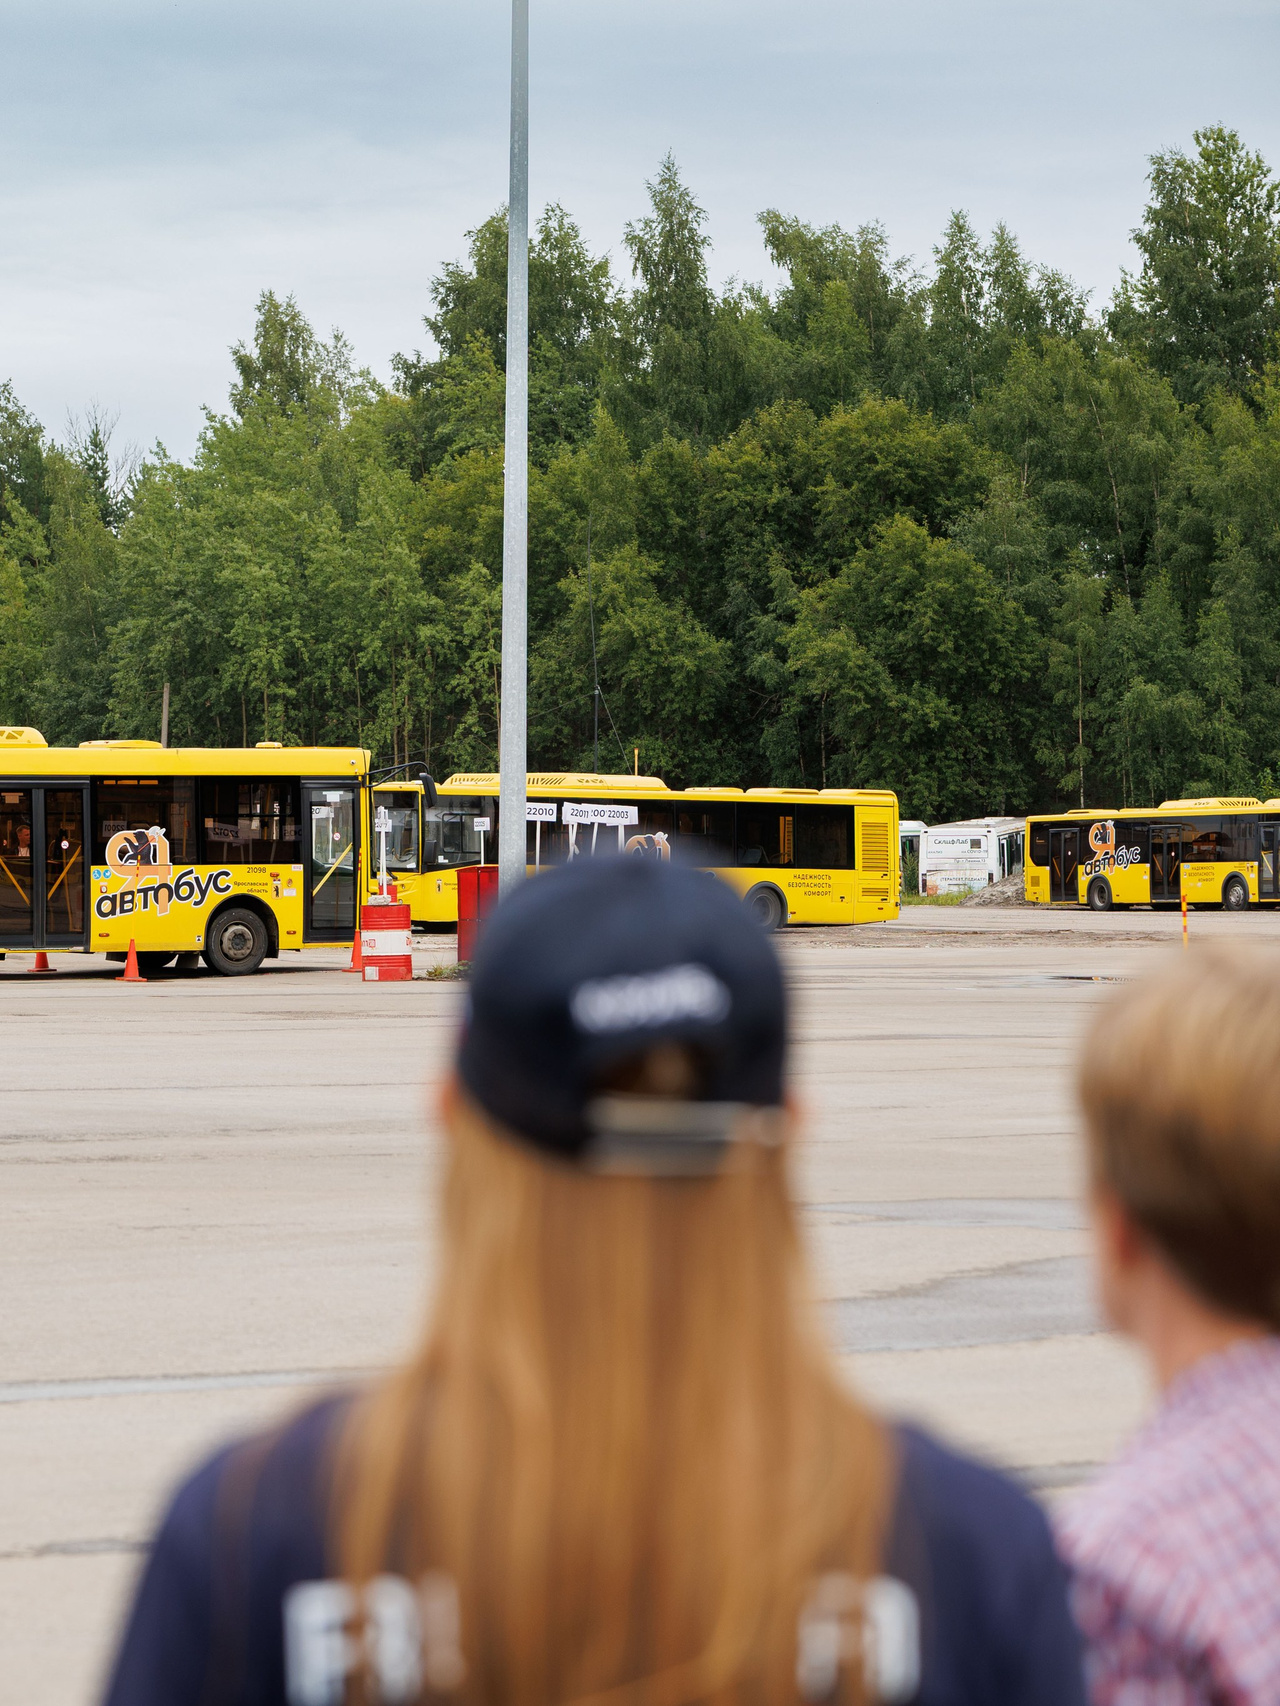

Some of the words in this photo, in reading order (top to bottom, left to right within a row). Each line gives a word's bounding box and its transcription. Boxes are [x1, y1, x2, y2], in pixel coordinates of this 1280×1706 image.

[527, 807, 554, 816] 22010
[570, 808, 589, 819] 22011
[607, 809, 629, 819] 22003
[1084, 845, 1141, 876] автобус
[246, 866, 267, 874] 21098
[793, 873, 832, 881] НАДЕЖНОСТЬ
[787, 881, 832, 889] БЕЗОПАСНОСТЬ
[95, 867, 233, 919] автобус
